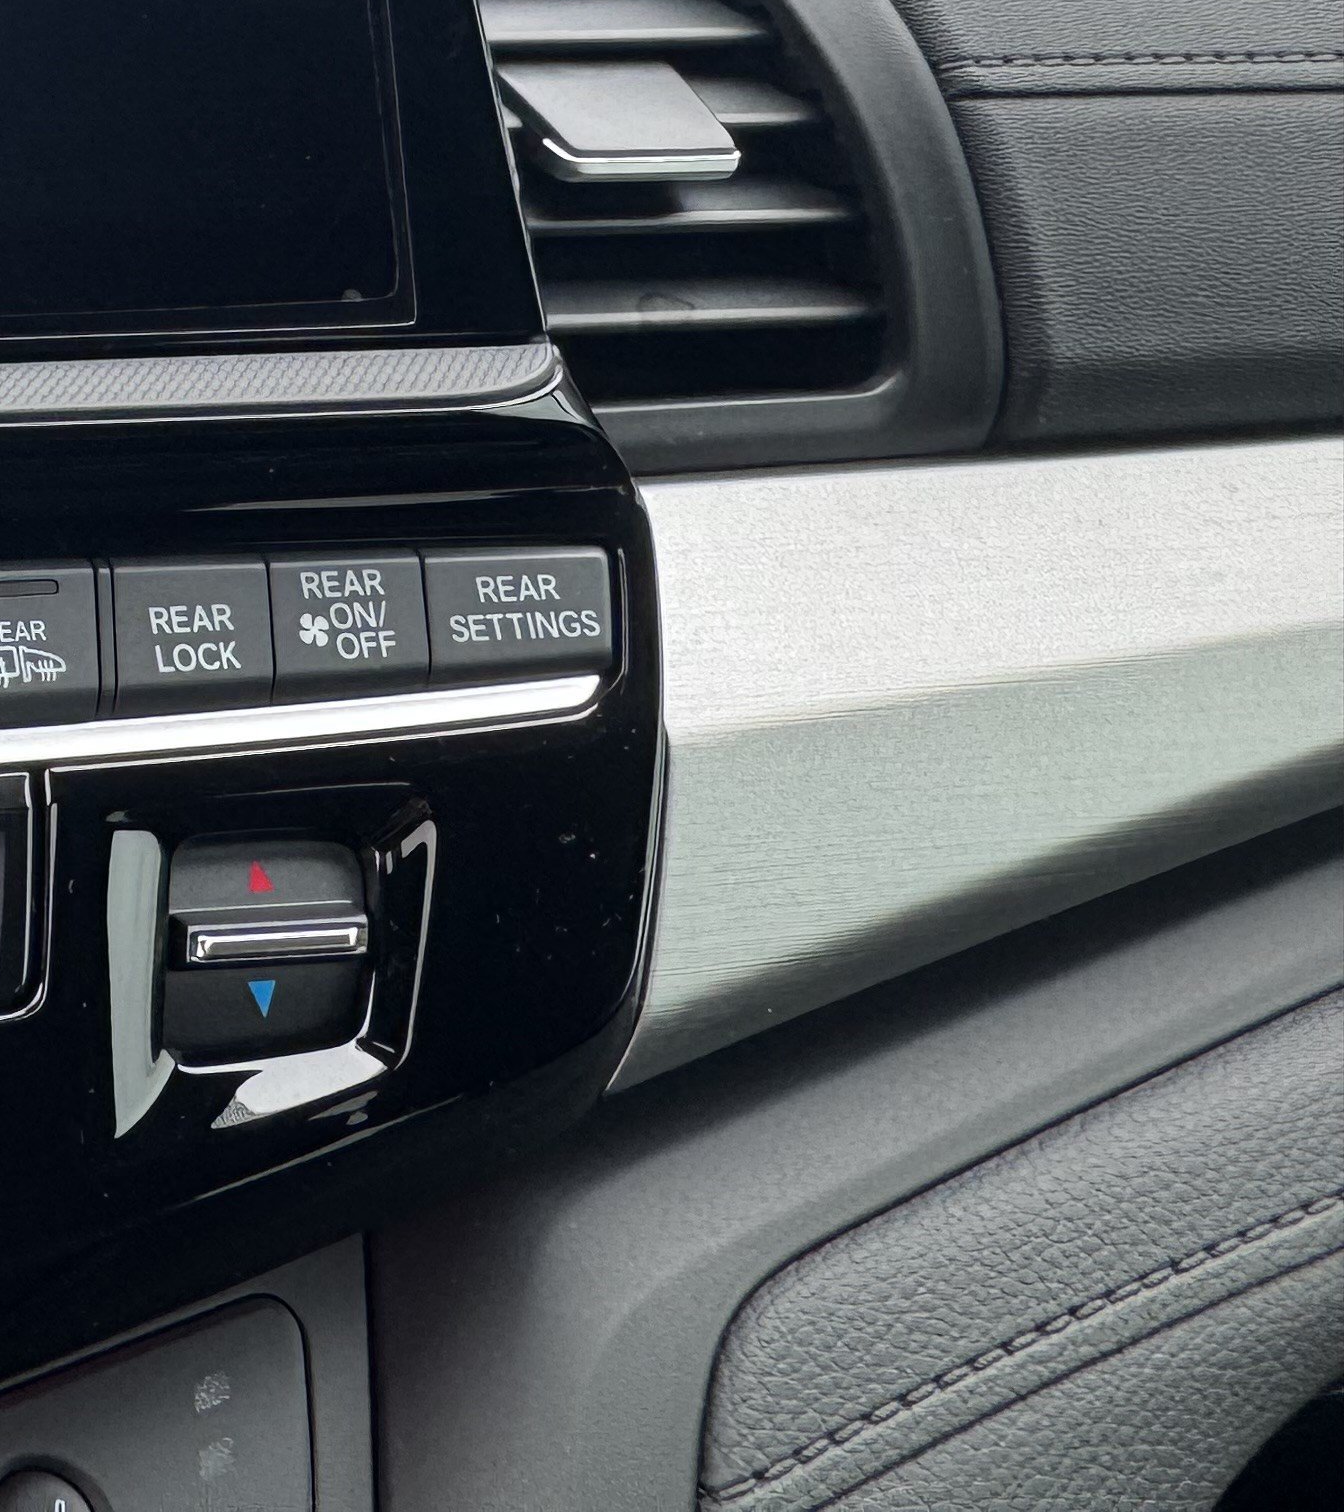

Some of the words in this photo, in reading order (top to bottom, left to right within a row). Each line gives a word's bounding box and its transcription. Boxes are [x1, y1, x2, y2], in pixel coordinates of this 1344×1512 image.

[299, 568, 386, 599] REAR
[475, 573, 562, 603] REAR
[148, 603, 236, 635] REAR
[329, 599, 386, 630] ON/
[449, 609, 602, 643] SETTINGS
[154, 639, 243, 673] LOCK
[335, 629, 396, 660] OFF
